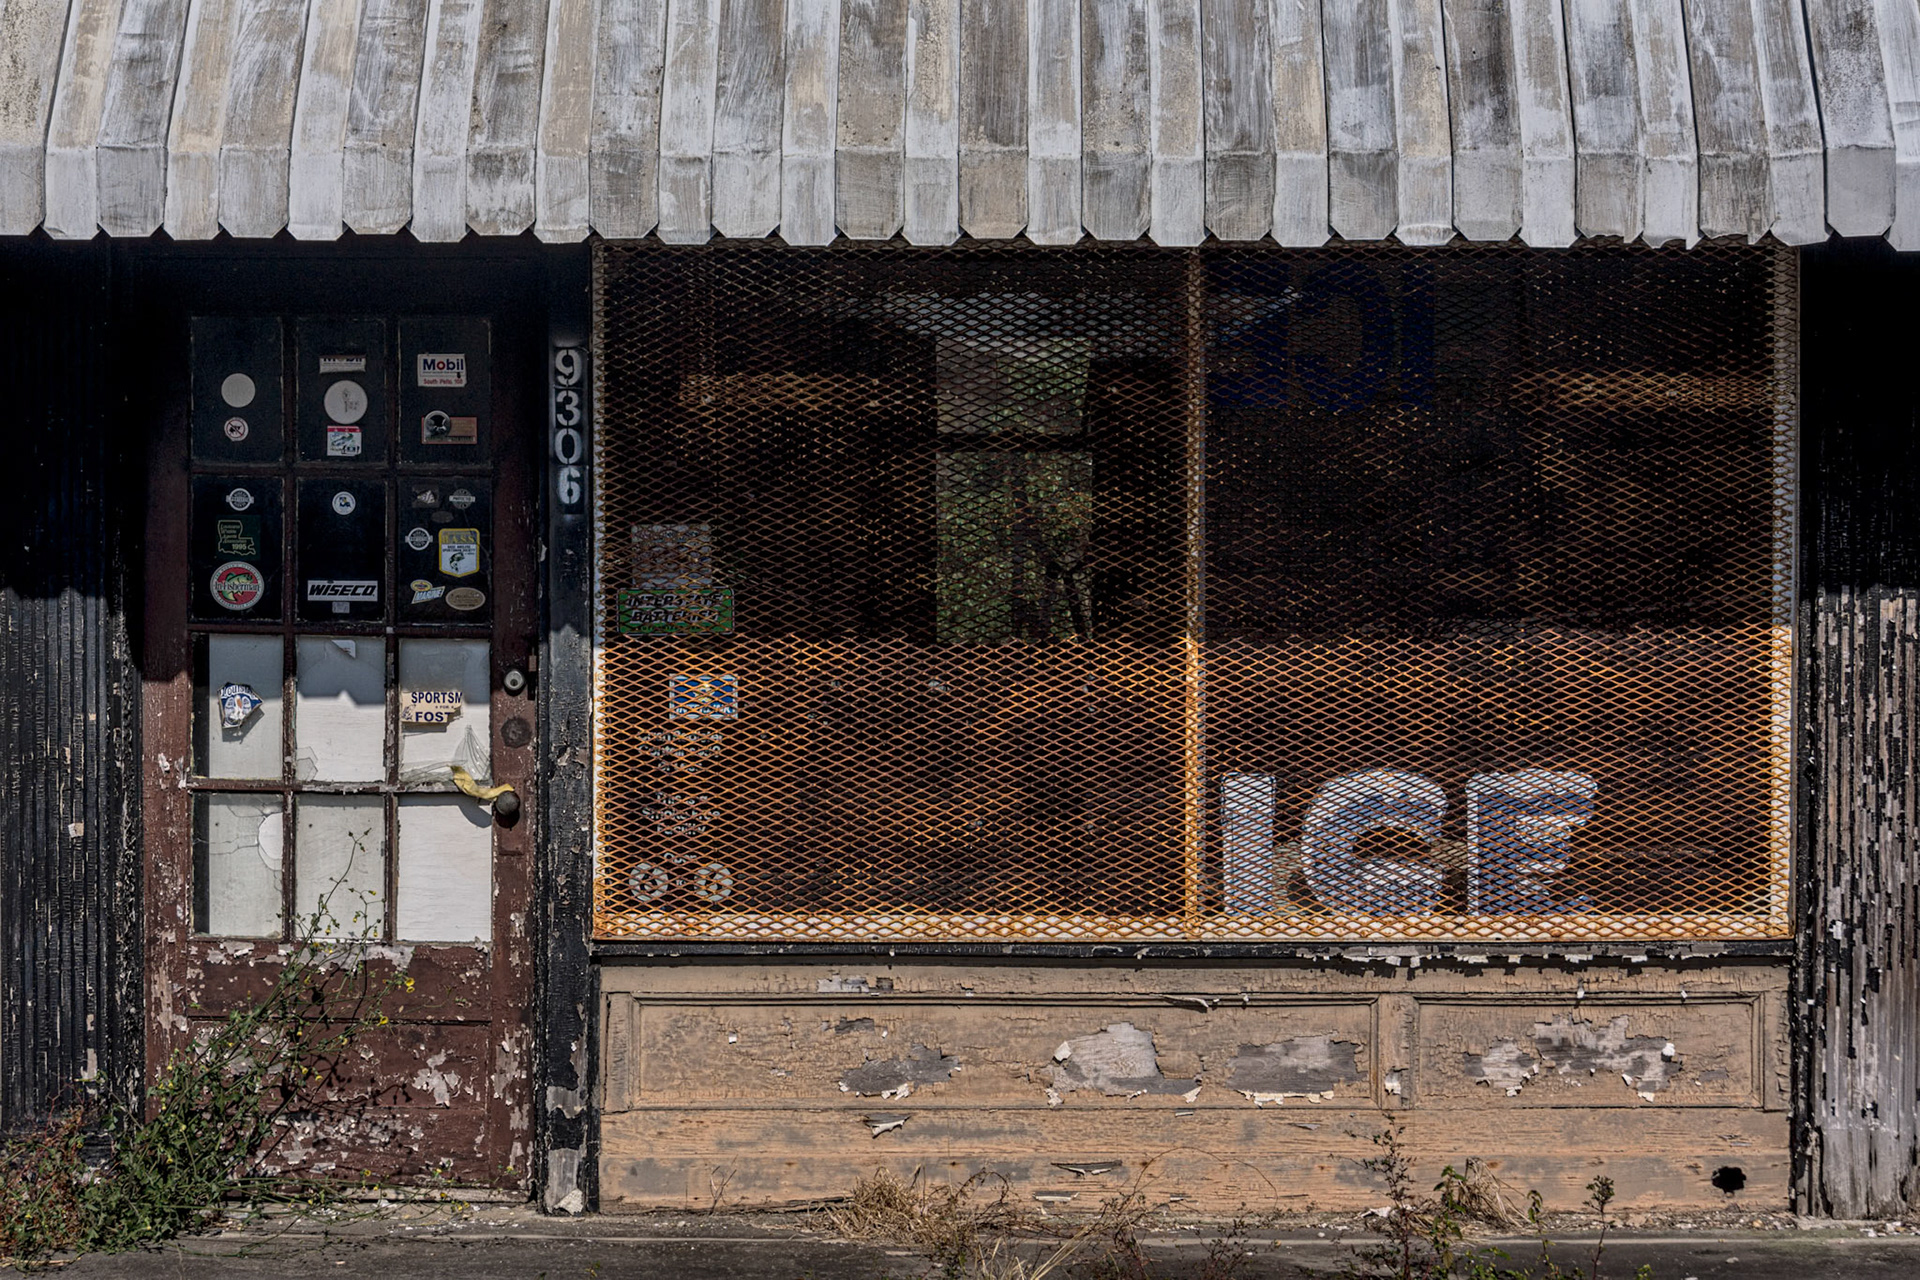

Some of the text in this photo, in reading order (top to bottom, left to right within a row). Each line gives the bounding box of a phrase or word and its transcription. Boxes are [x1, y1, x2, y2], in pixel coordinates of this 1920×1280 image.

[422, 358, 464, 371] Mobil
[555, 349, 582, 504] 9306
[309, 584, 376, 597] WISECO
